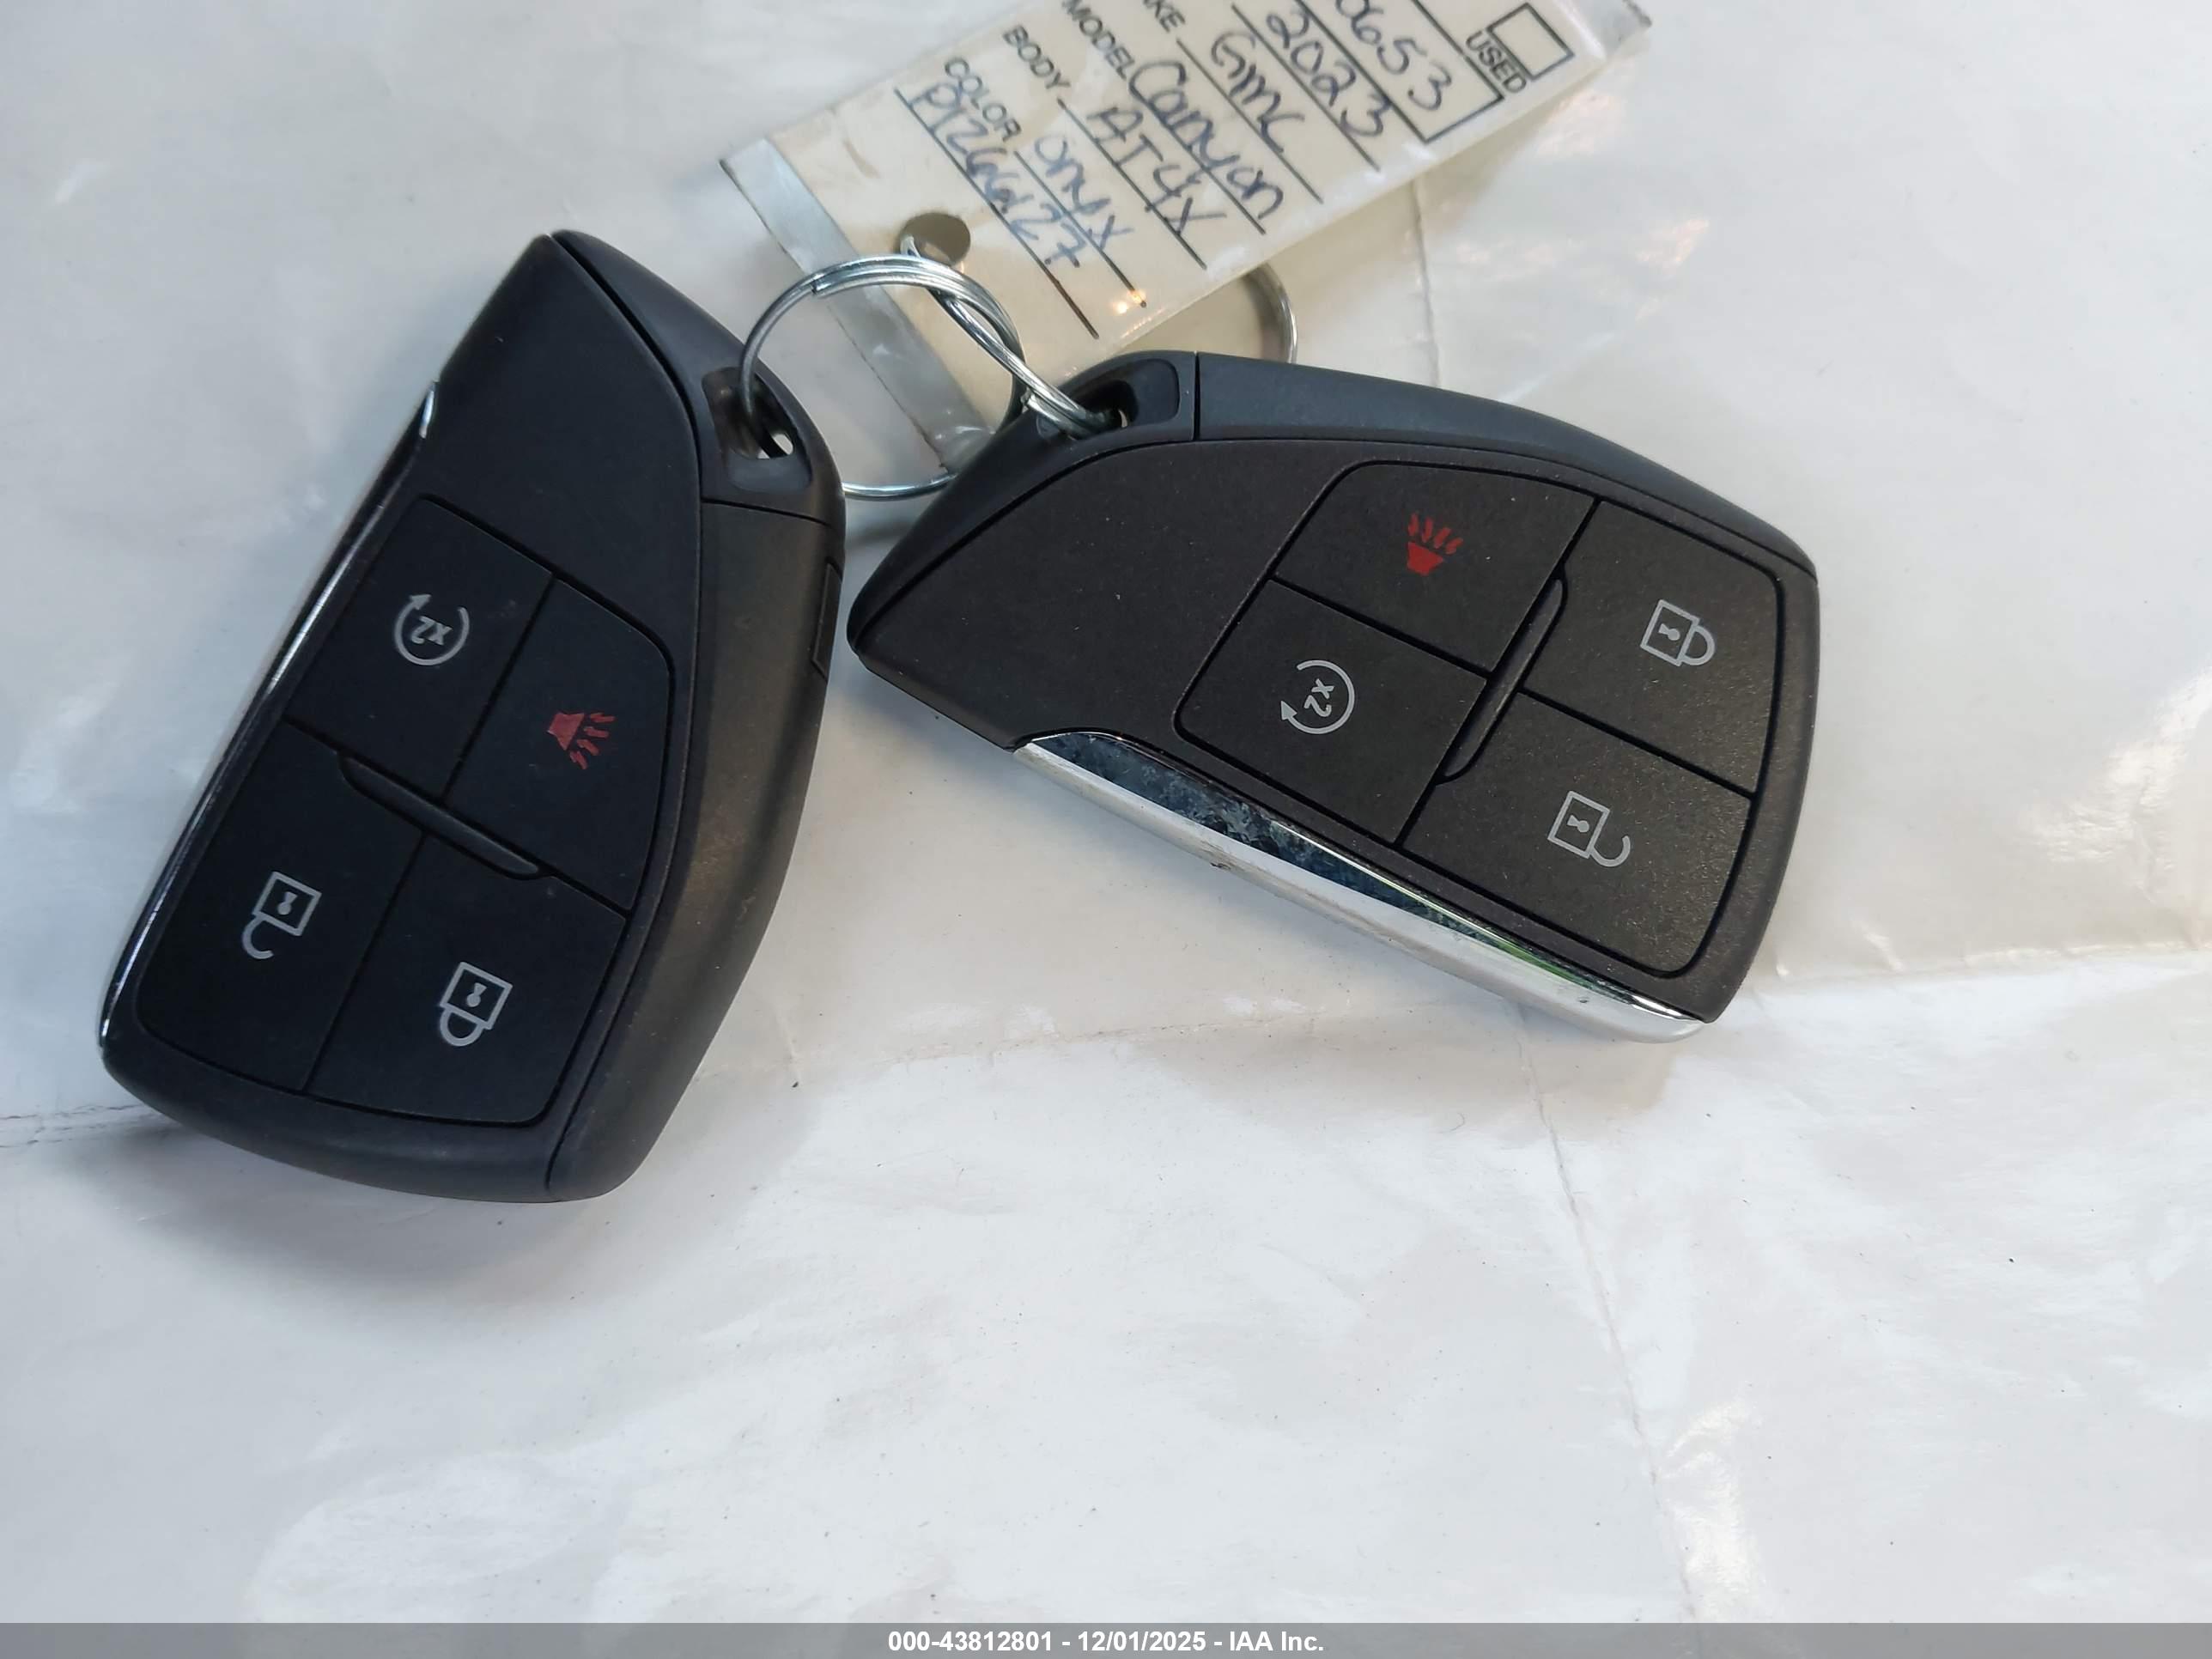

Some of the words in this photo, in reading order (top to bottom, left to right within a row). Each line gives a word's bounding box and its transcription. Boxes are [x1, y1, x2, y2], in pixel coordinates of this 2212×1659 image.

[1062, 0, 1135, 80] MODEL
[1143, 0, 1186, 33] KE
[1004, 25, 1071, 91] BODY
[1267, 11, 1393, 137] 2023
[1465, 30, 1528, 94] USED
[945, 57, 1021, 142] COLOR
[1129, 60, 1283, 221] Canyon
